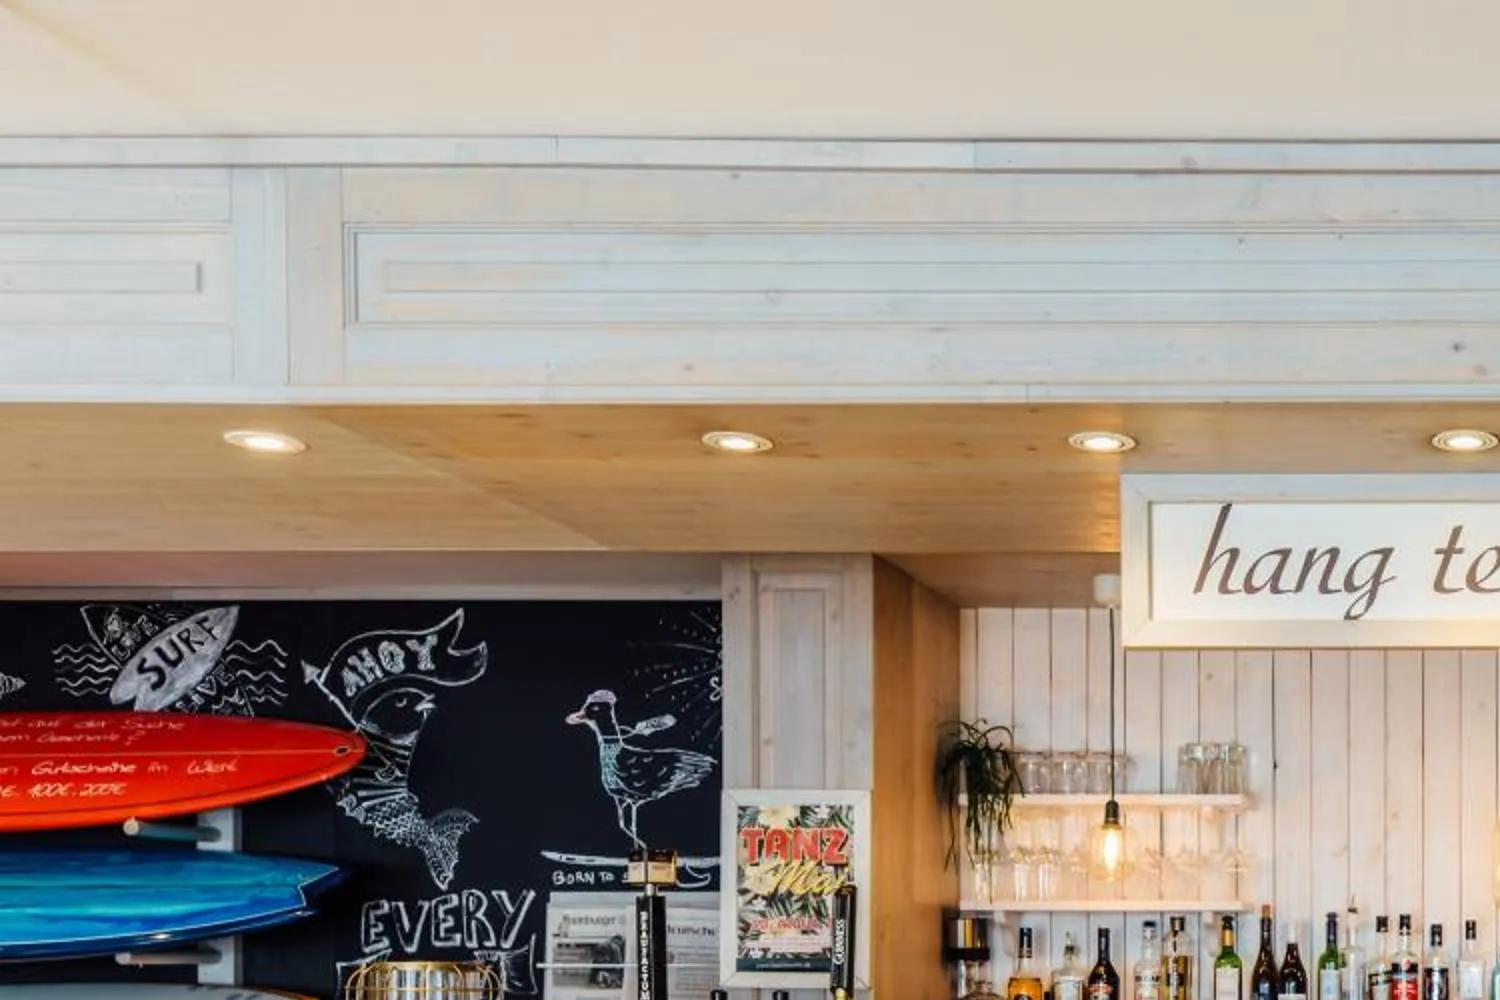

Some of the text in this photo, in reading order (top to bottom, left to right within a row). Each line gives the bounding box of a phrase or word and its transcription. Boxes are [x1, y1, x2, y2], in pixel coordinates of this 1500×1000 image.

[1193, 502, 1395, 621] hang
[137, 615, 219, 691] SURF
[339, 634, 439, 698] AHOY
[552, 871, 595, 885] BORN
[600, 871, 615, 882] TO
[739, 826, 849, 867] TANZ
[360, 889, 536, 954] EVERY
